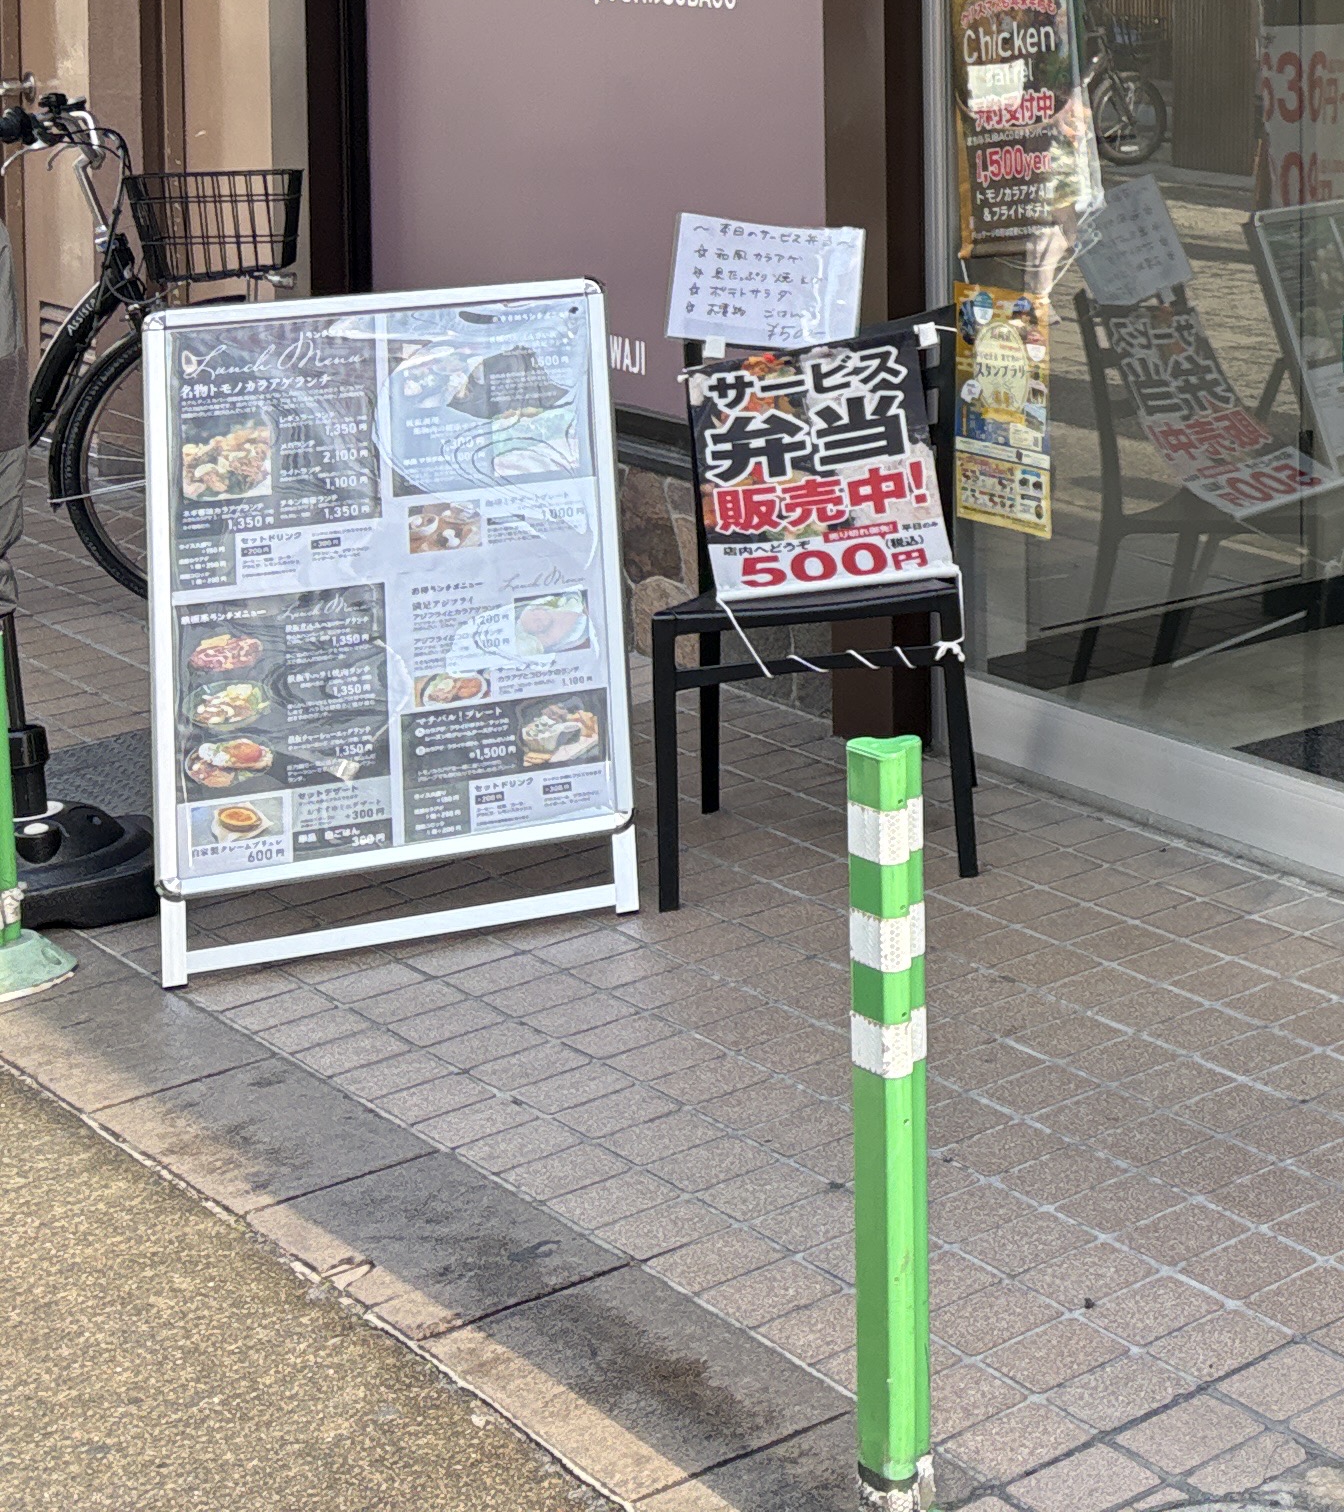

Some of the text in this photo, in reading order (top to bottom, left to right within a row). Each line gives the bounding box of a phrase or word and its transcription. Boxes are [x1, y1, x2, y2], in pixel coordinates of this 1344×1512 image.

[963, 21, 1056, 63] Chicken
[705, 347, 908, 413] サービス
[705, 391, 908, 486] 弁当
[712, 460, 930, 535] 販売中!
[227, 515, 274, 531] 1,350円
[723, 540, 811, 557] 店内へどうぞ
[741, 542, 929, 587] 500円
[248, 848, 285, 863] 600円
